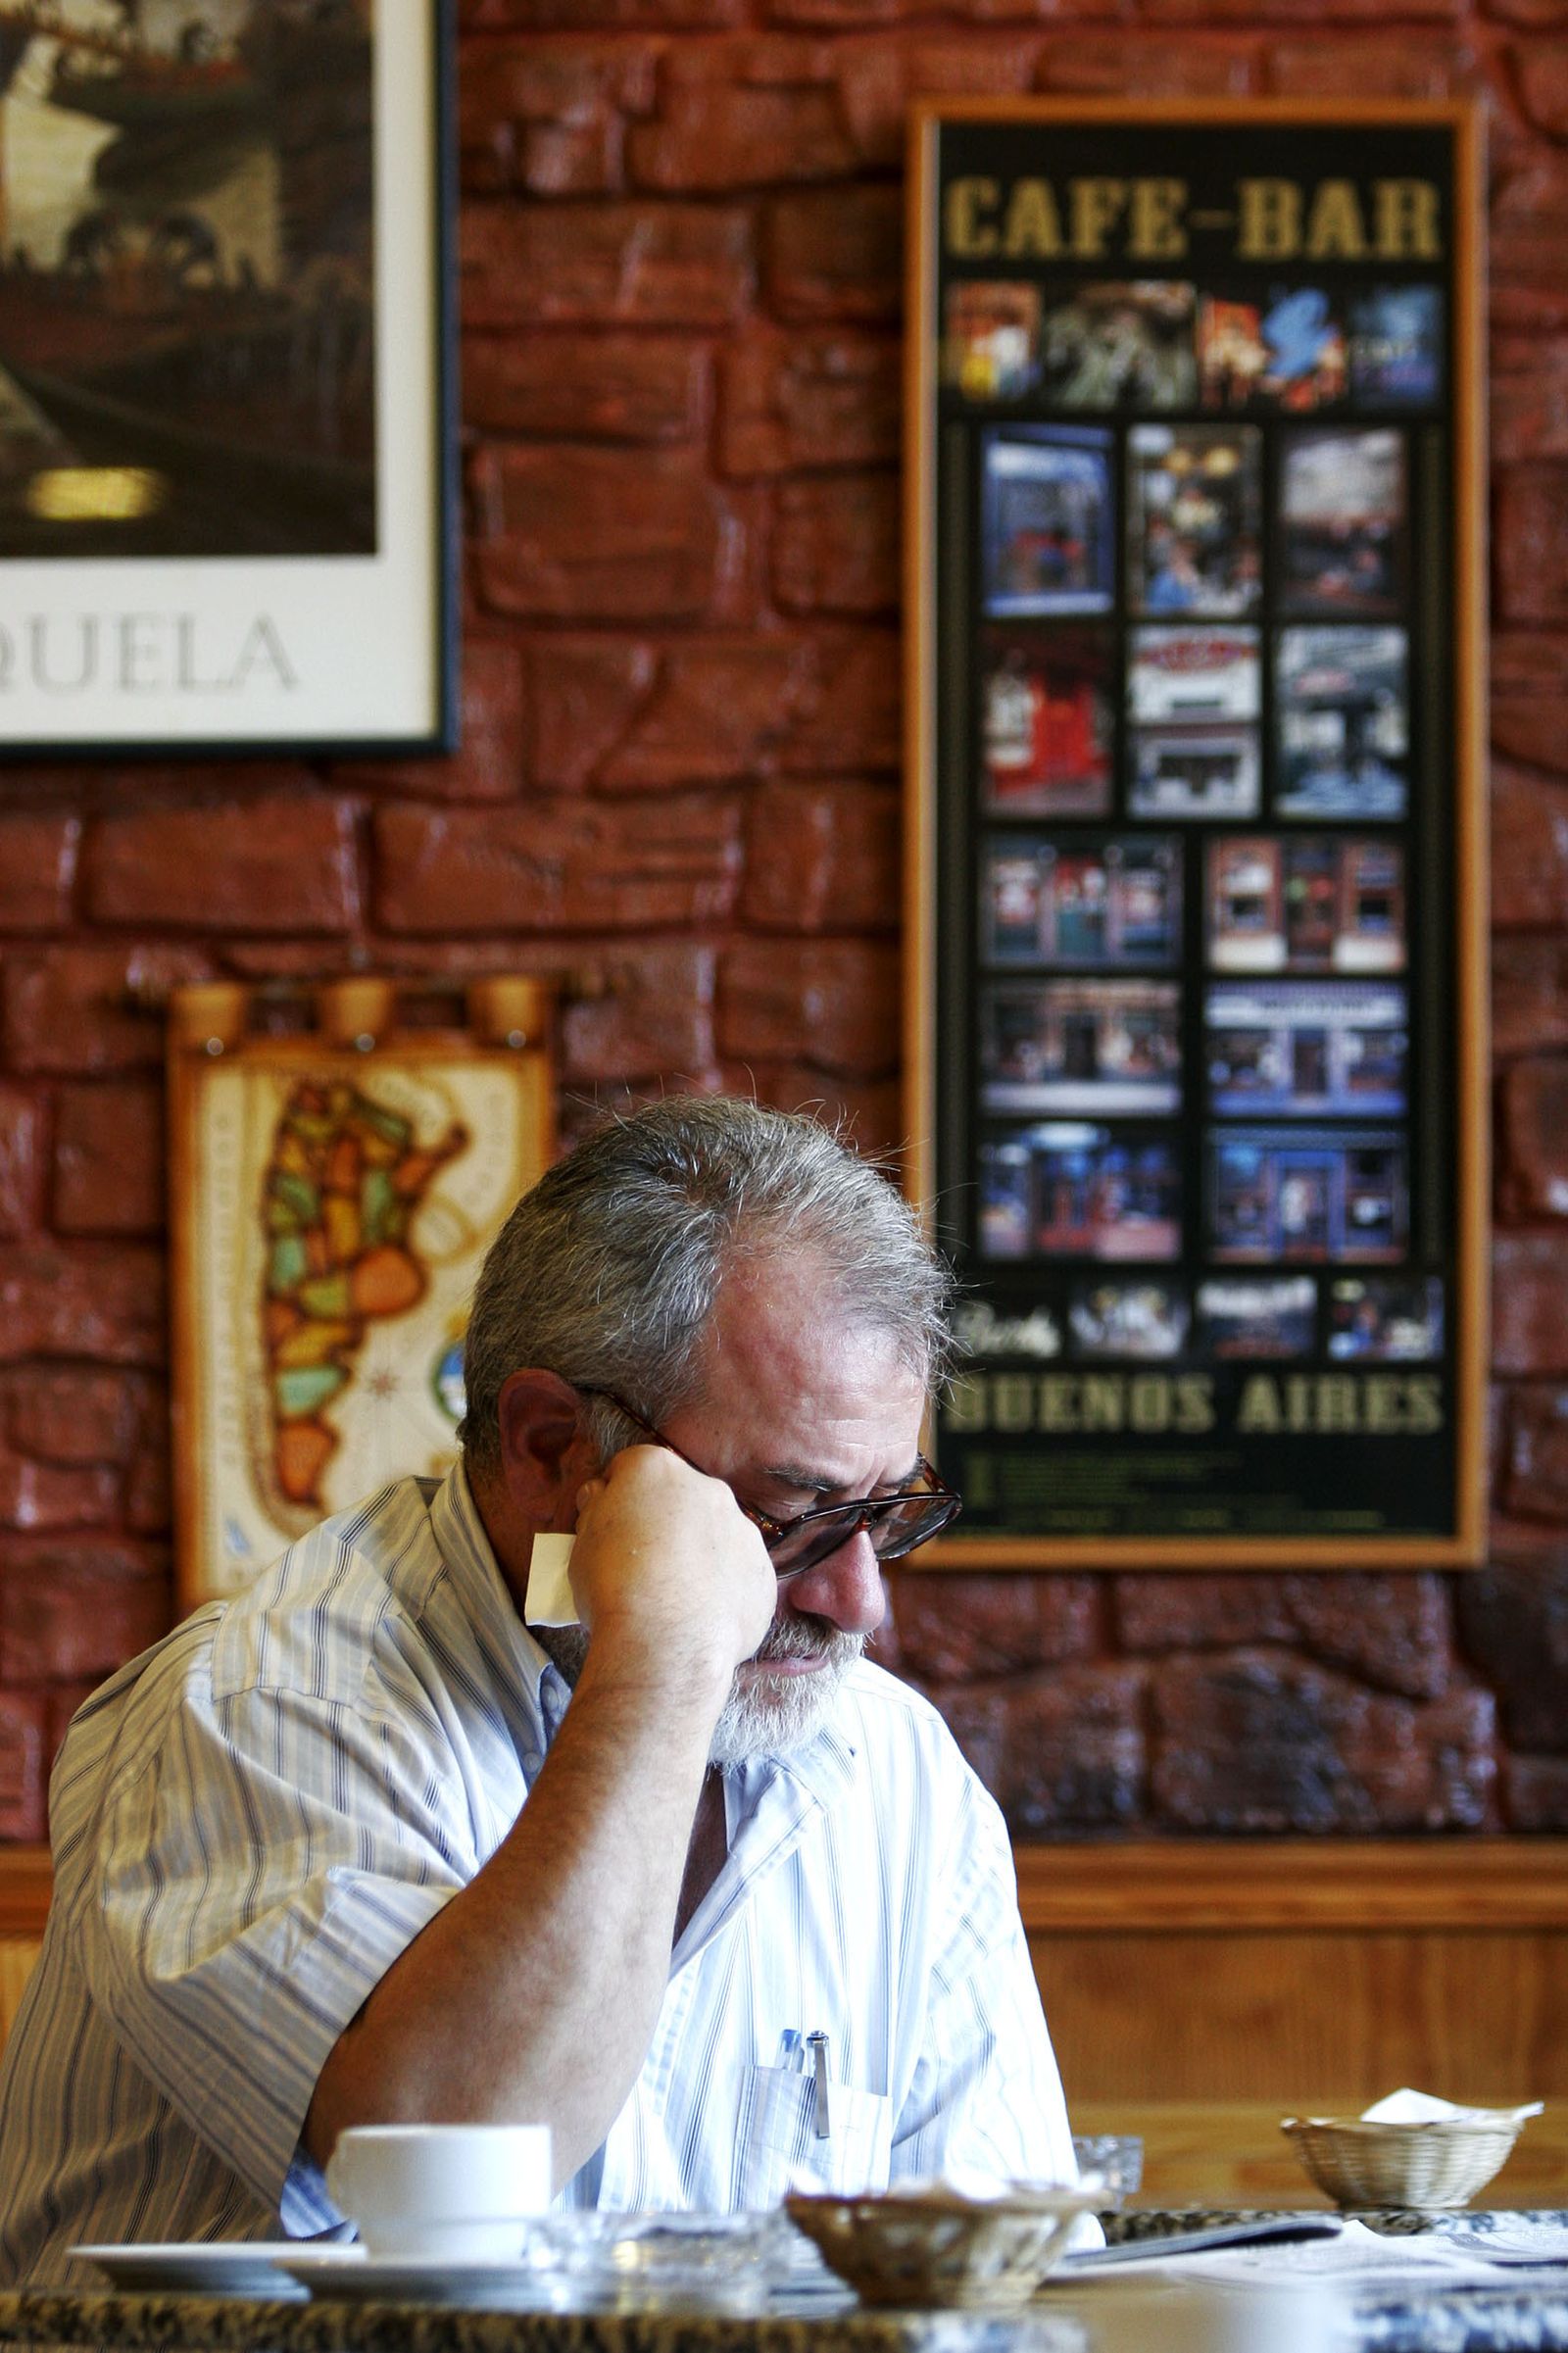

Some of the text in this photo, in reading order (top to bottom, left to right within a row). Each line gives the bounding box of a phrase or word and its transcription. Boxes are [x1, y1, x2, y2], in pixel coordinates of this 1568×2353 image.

[0, 612, 300, 695] UELA
[946, 1371, 1445, 1434] BUENOS AIRES
